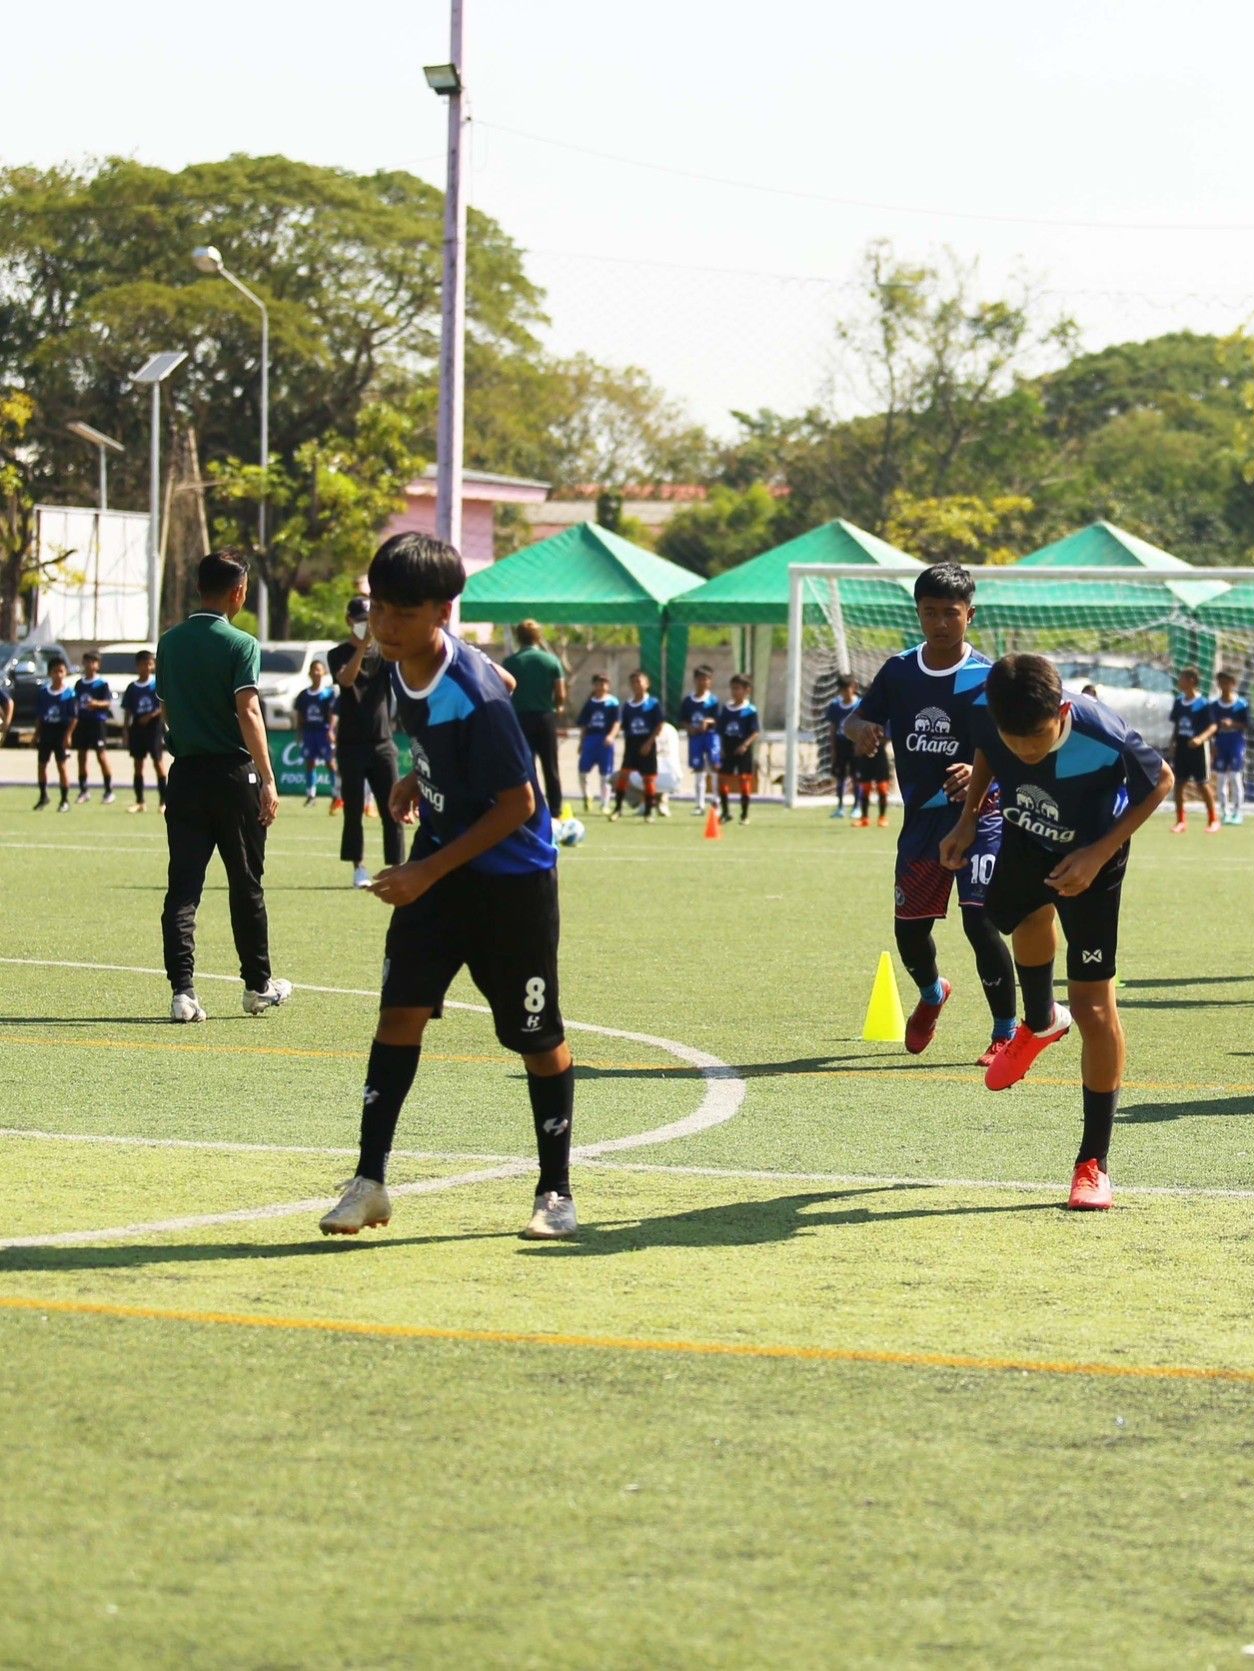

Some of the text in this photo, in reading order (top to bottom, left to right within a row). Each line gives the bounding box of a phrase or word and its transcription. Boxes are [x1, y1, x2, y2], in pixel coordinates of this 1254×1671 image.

[906, 733, 959, 756] Chang
[1003, 807, 1075, 843] Chang
[970, 853, 996, 885] 10
[524, 976, 545, 1013] 8
